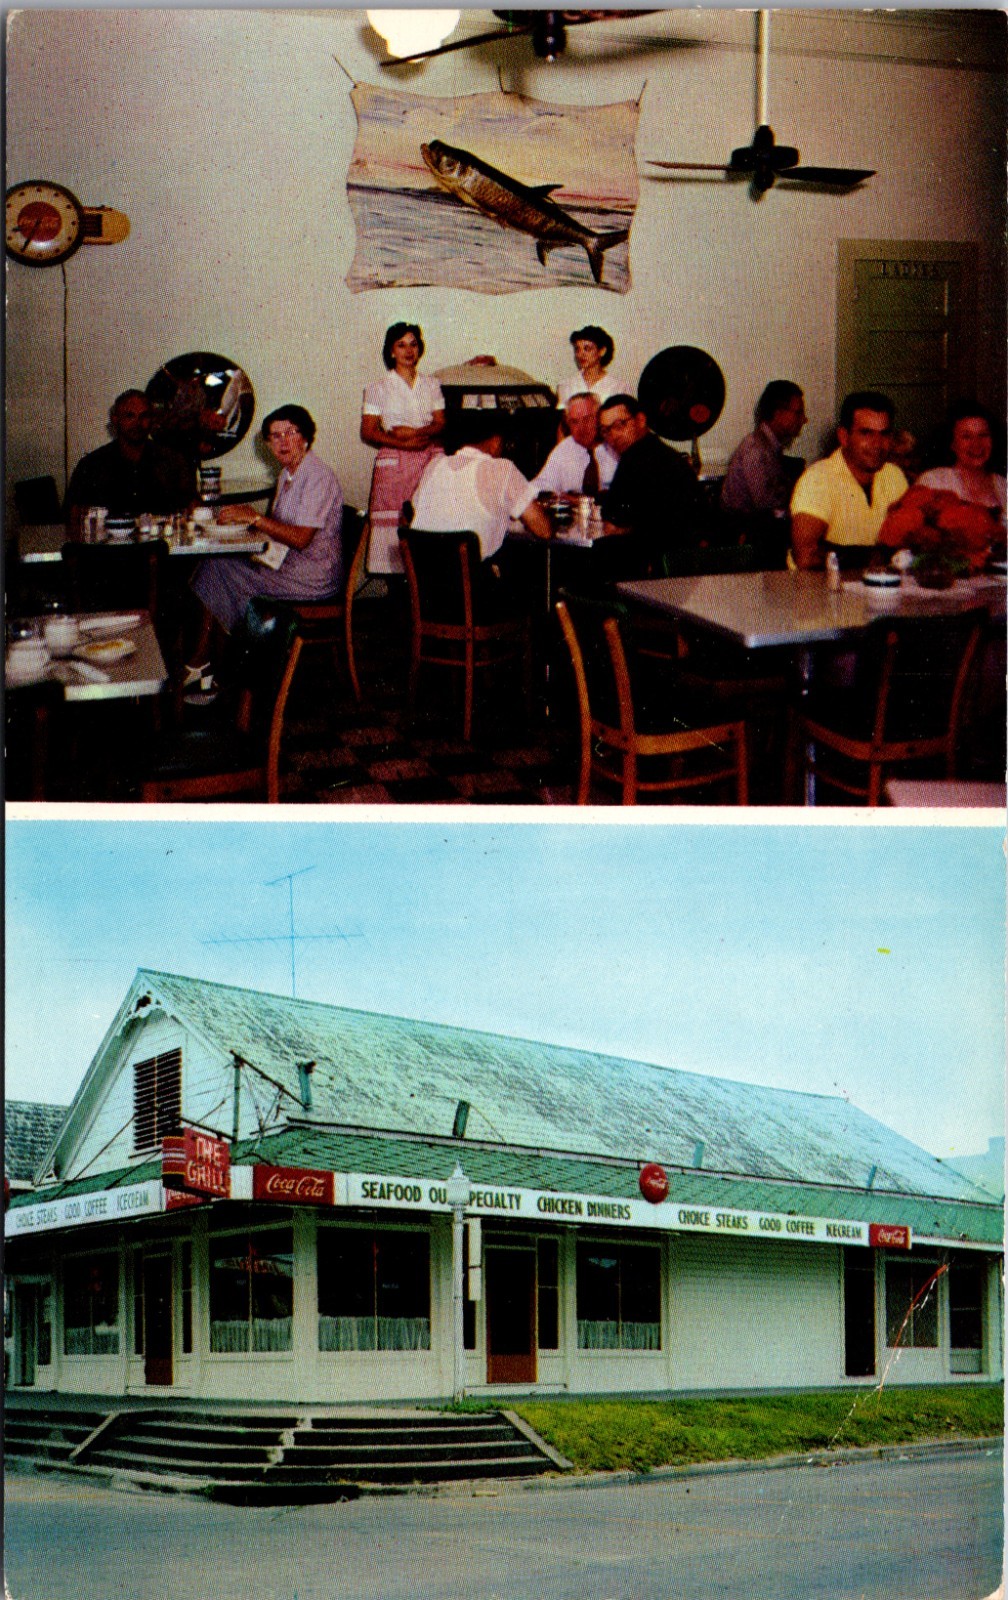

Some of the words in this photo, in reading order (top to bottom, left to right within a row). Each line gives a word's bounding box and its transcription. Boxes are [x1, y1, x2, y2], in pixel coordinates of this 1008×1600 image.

[193, 1135, 224, 1166] THE
[186, 1159, 227, 1193] GRILL
[36, 1206, 58, 1225] STEAKS
[65, 1201, 81, 1219] GOOD
[84, 1197, 108, 1217] COFFEE
[360, 1181, 422, 1203] SEAFOOD
[428, 1186, 448, 1205] OU
[466, 1189, 522, 1210] PECIALTY
[536, 1195, 584, 1216] CHICKEN
[587, 1201, 631, 1220] DINNERS
[678, 1209, 711, 1227] CHOICE
[715, 1212, 749, 1230] STEAKS
[759, 1216, 782, 1232] GOOD
[785, 1220, 816, 1236] COFFEE
